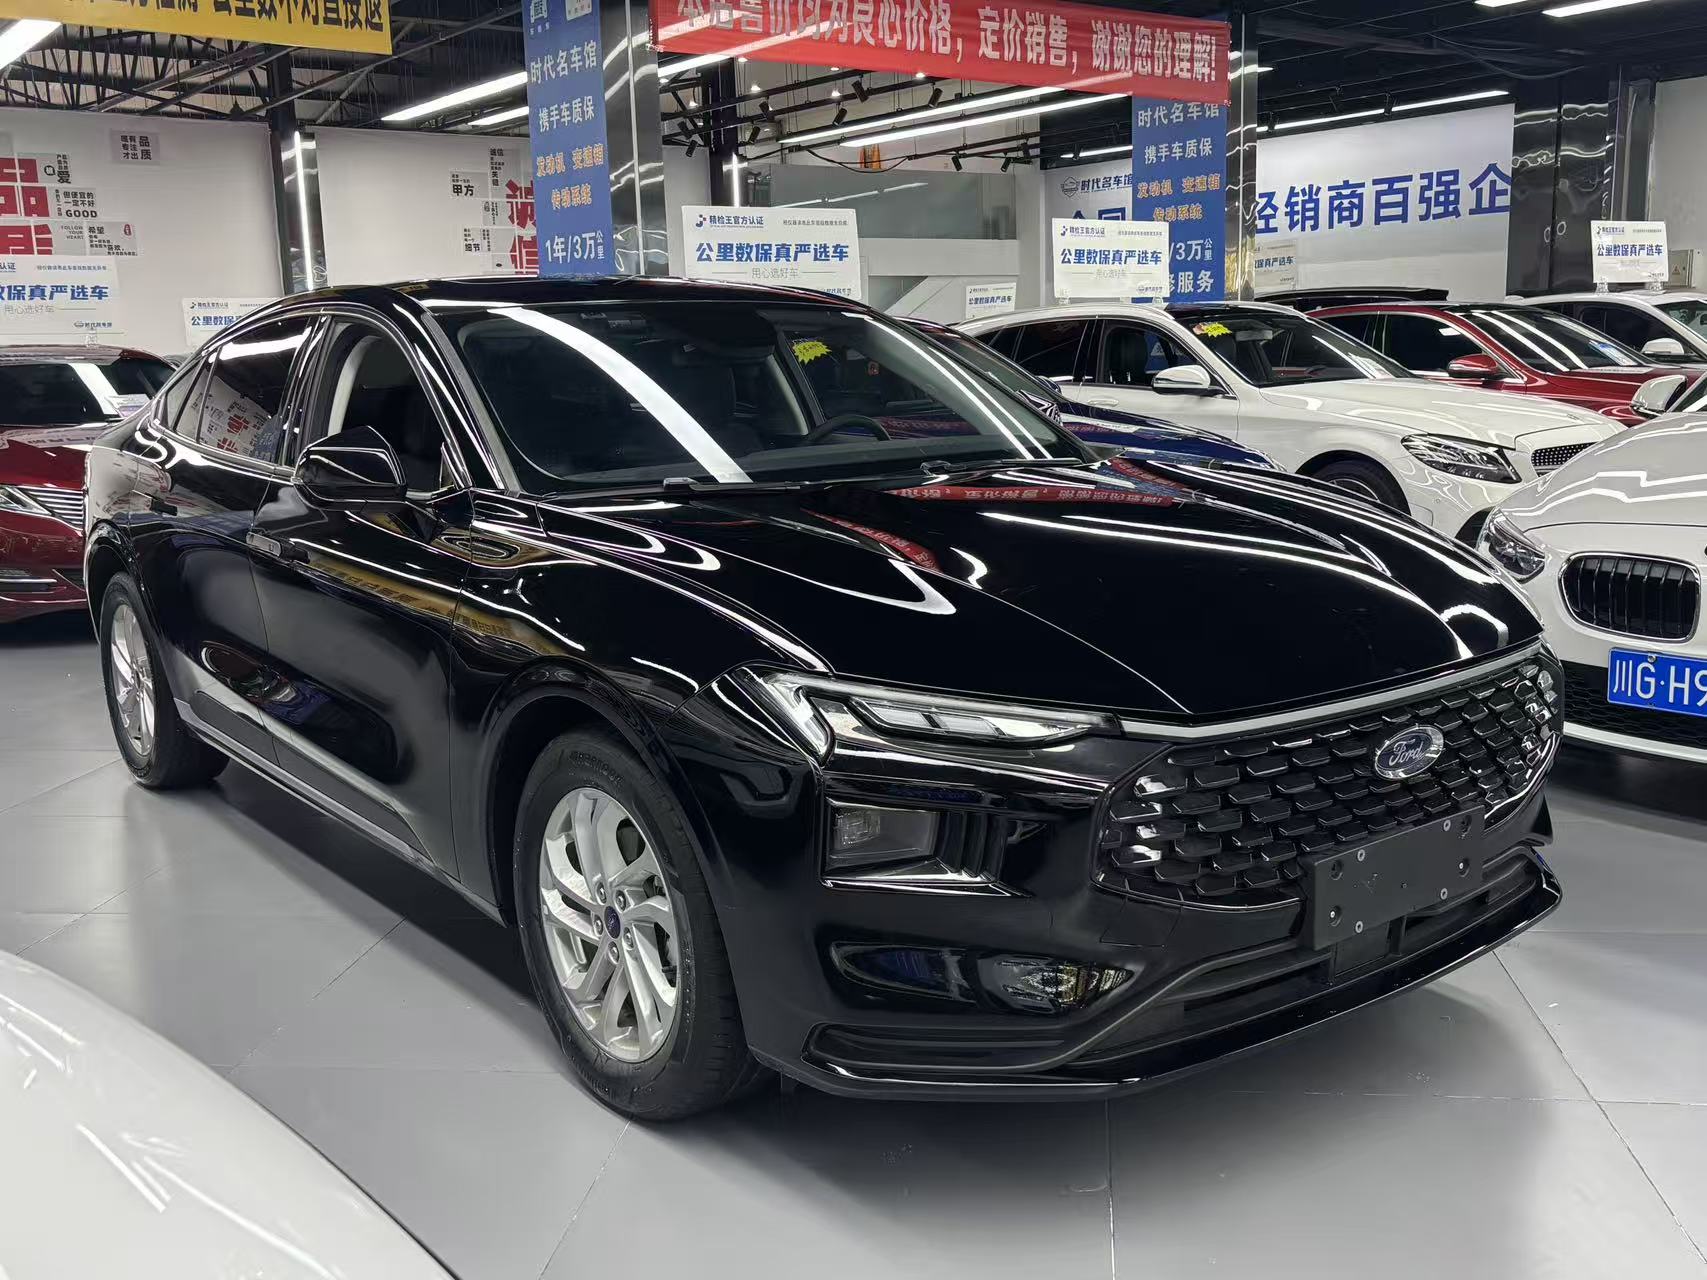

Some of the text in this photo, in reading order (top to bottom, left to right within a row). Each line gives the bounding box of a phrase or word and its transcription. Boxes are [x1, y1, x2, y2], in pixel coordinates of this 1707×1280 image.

[530, 40, 597, 84] 时代名车馆
[539, 96, 595, 132] 携手车质保
[1144, 138, 1212, 164] 携手车质保
[63, 191, 94, 199] 但便宜的
[453, 183, 474, 197] 甲方
[1137, 179, 1173, 199] 发动机
[66, 209, 98, 218] GOOD
[709, 215, 764, 226] 精检王官方认证
[1152, 204, 1203, 222] 传动系统
[696, 242, 849, 262] 公里数保真严选车
[1061, 248, 1162, 265] 公里数保真严选车
[1597, 244, 1663, 257] 公里数保真严选车
[751, 268, 799, 279] 用心选好车
[1388, 738, 1426, 767] Ford
